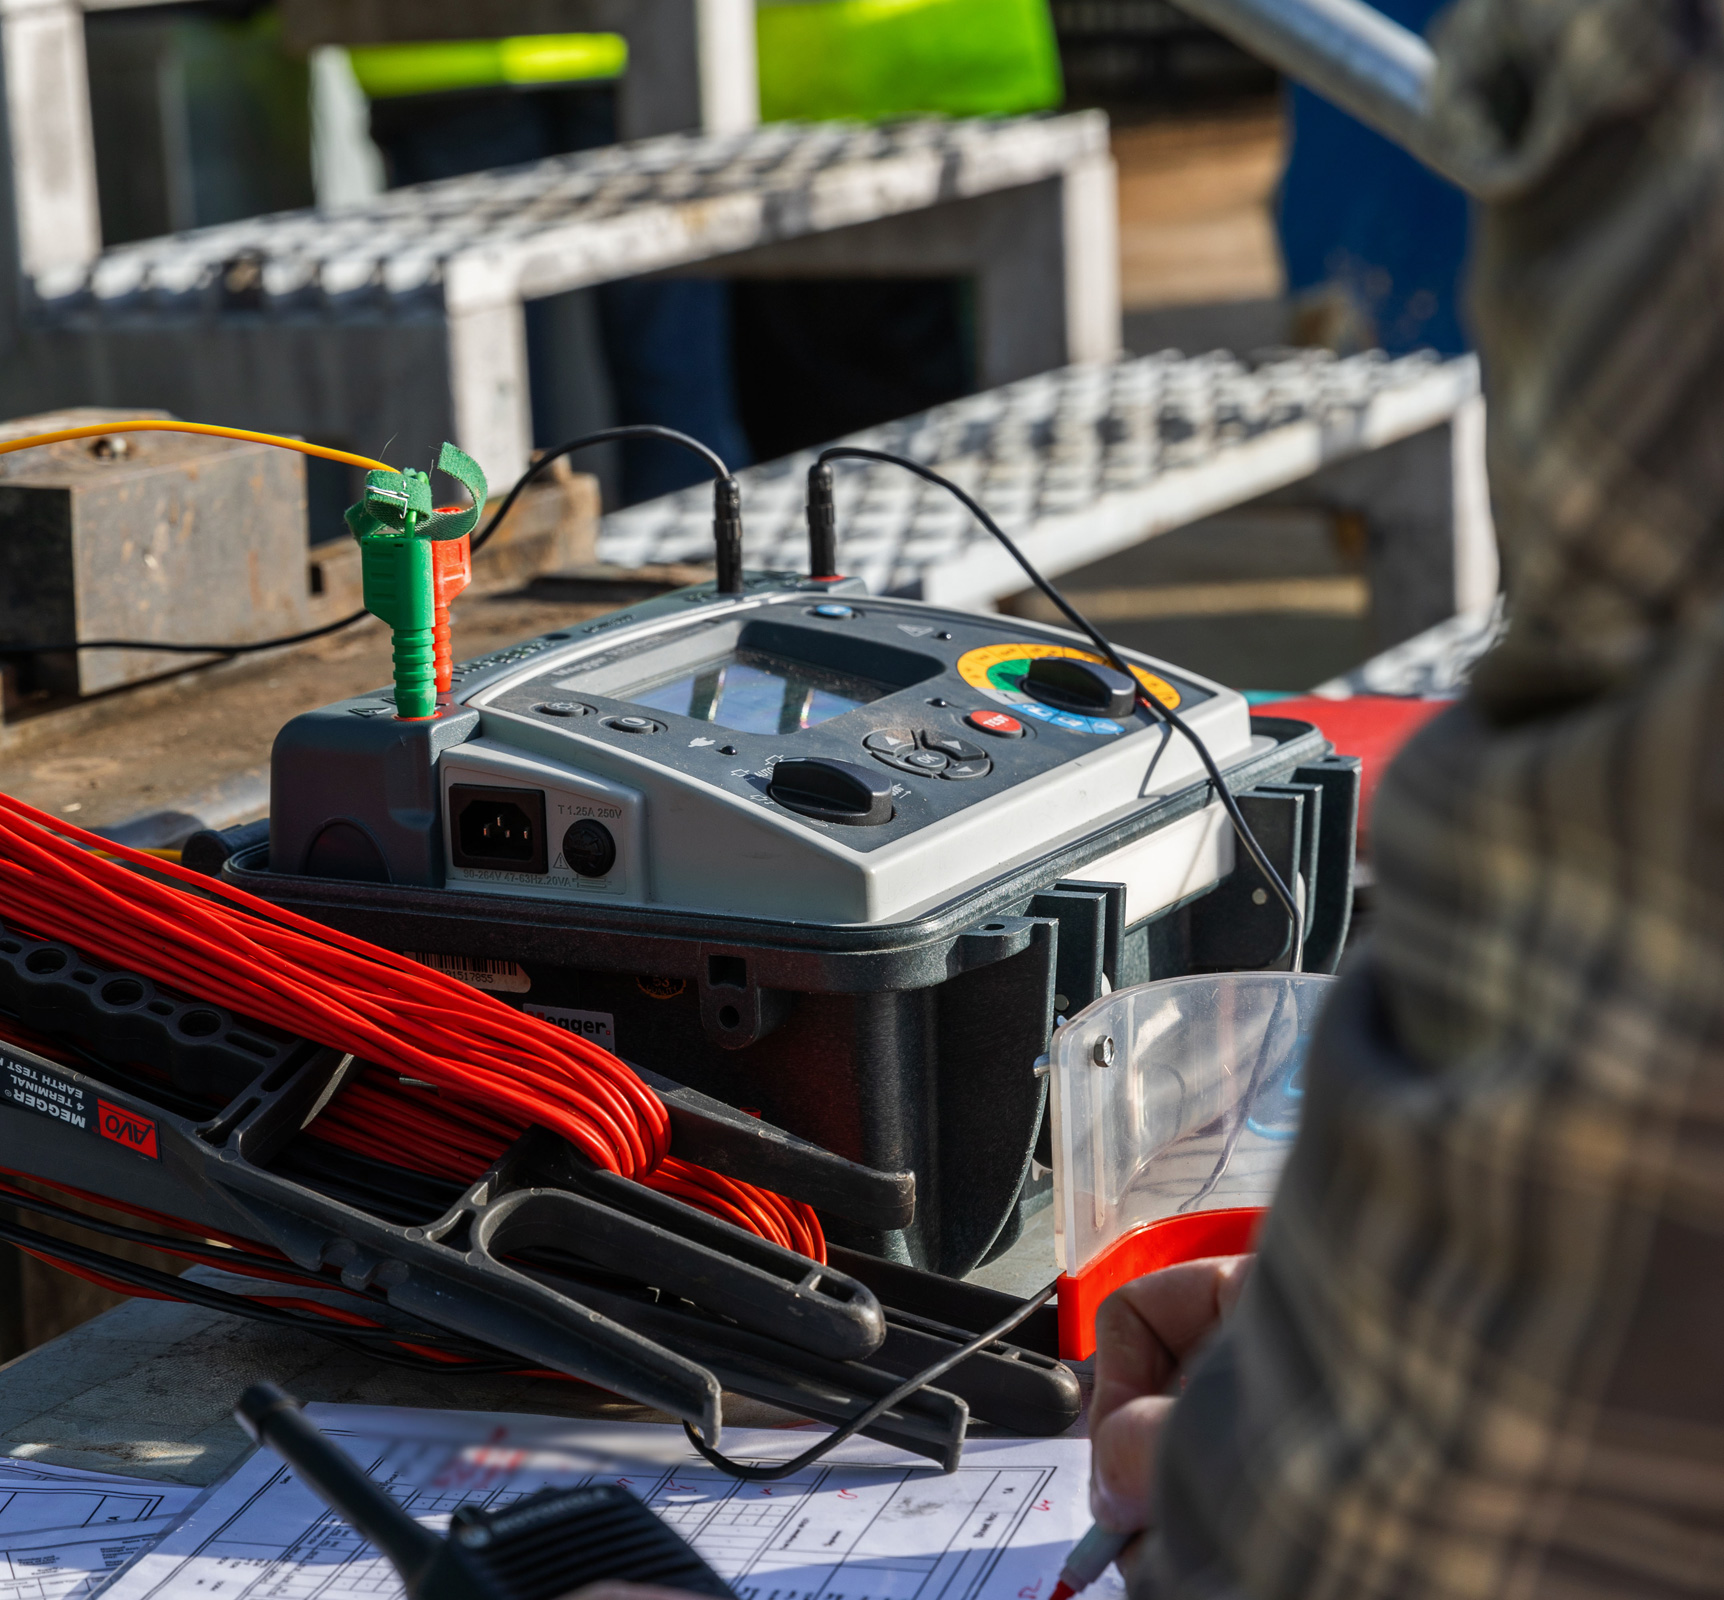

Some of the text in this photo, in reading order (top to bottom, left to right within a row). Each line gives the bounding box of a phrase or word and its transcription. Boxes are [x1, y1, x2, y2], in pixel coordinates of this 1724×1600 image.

[983, 714, 1010, 728] TEST
[916, 752, 940, 764] OK
[557, 804, 622, 819] T 1.25A 250V
[463, 868, 502, 881] 90-264V
[7, 1061, 39, 1081] TEST
[10, 1074, 85, 1111] 4 TERMINAL
[42, 1075, 83, 1099] EARTH
[105, 1114, 153, 1145] AVO
